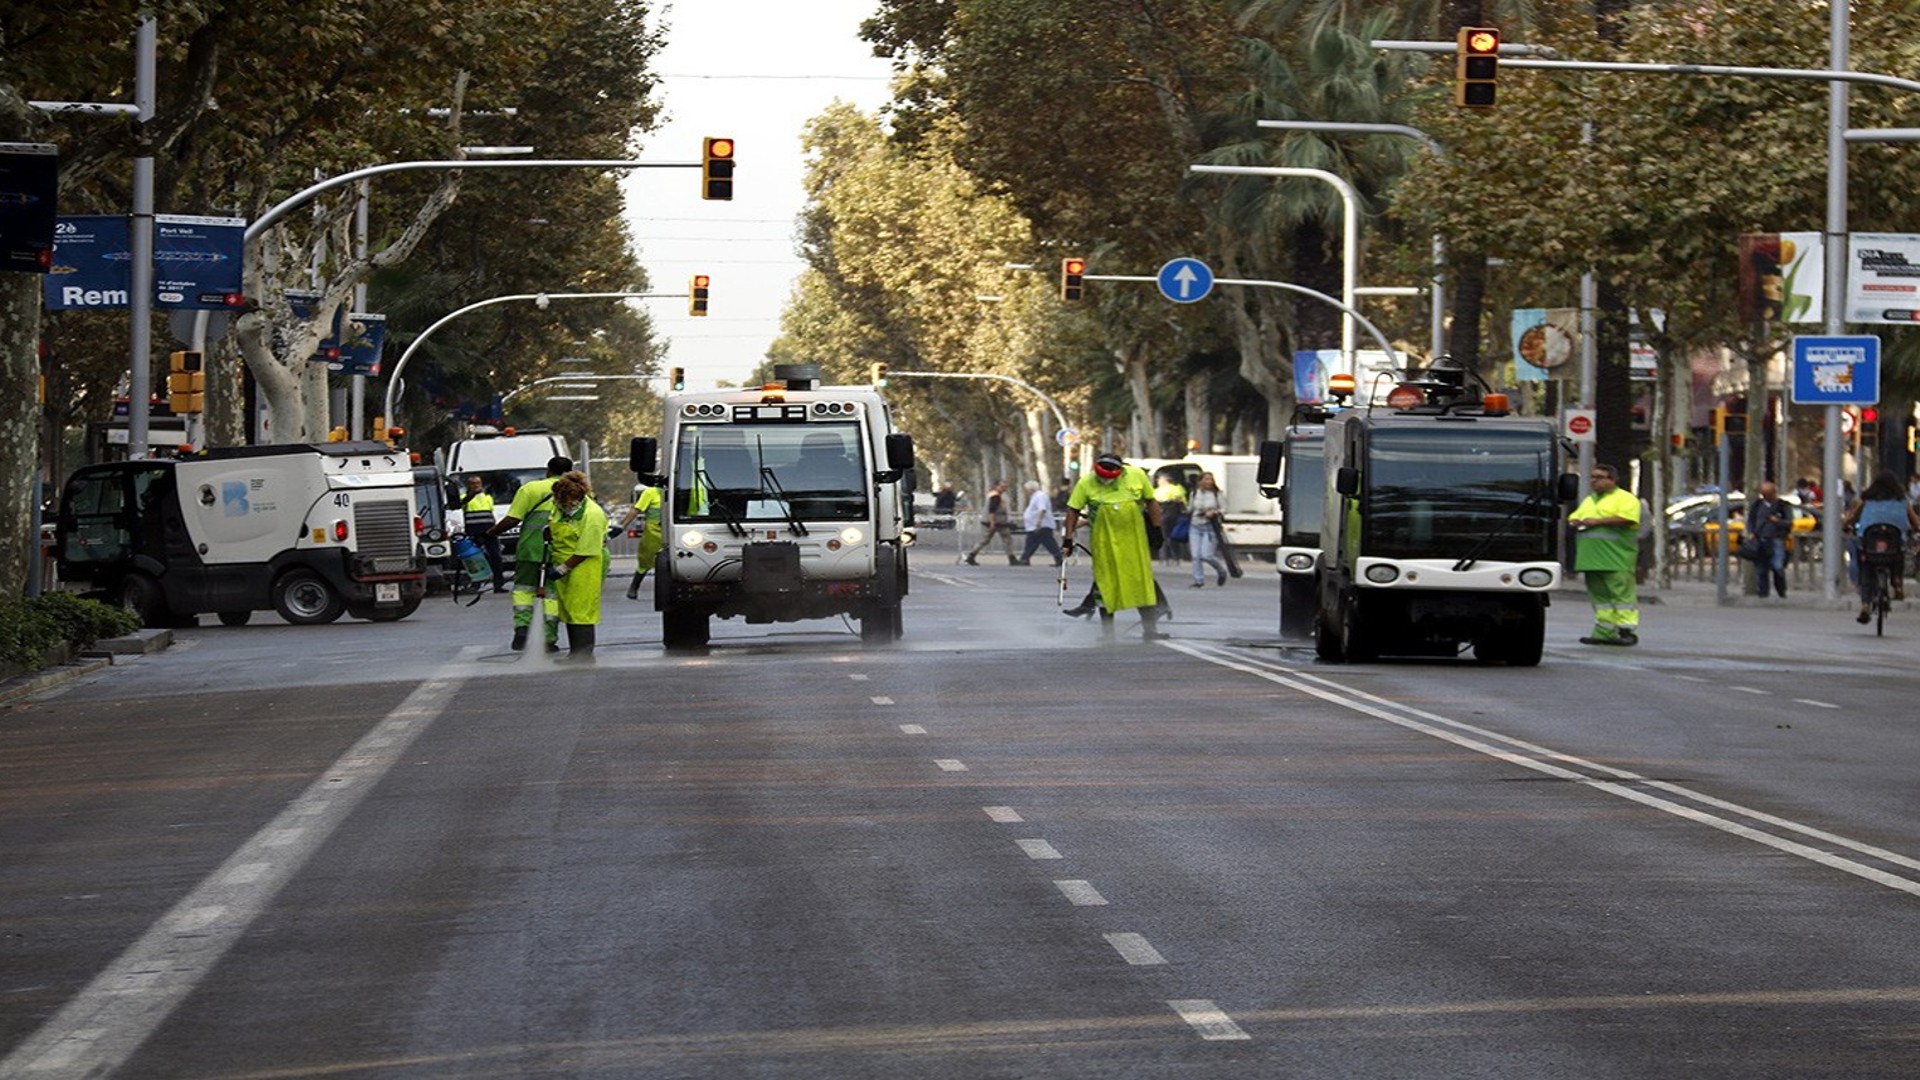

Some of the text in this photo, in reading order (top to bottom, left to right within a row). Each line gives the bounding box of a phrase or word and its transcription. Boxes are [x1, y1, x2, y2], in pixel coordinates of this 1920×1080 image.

[55, 222, 77, 234] 2è
[62, 285, 128, 306] Rem
[333, 492, 350, 508] 40
